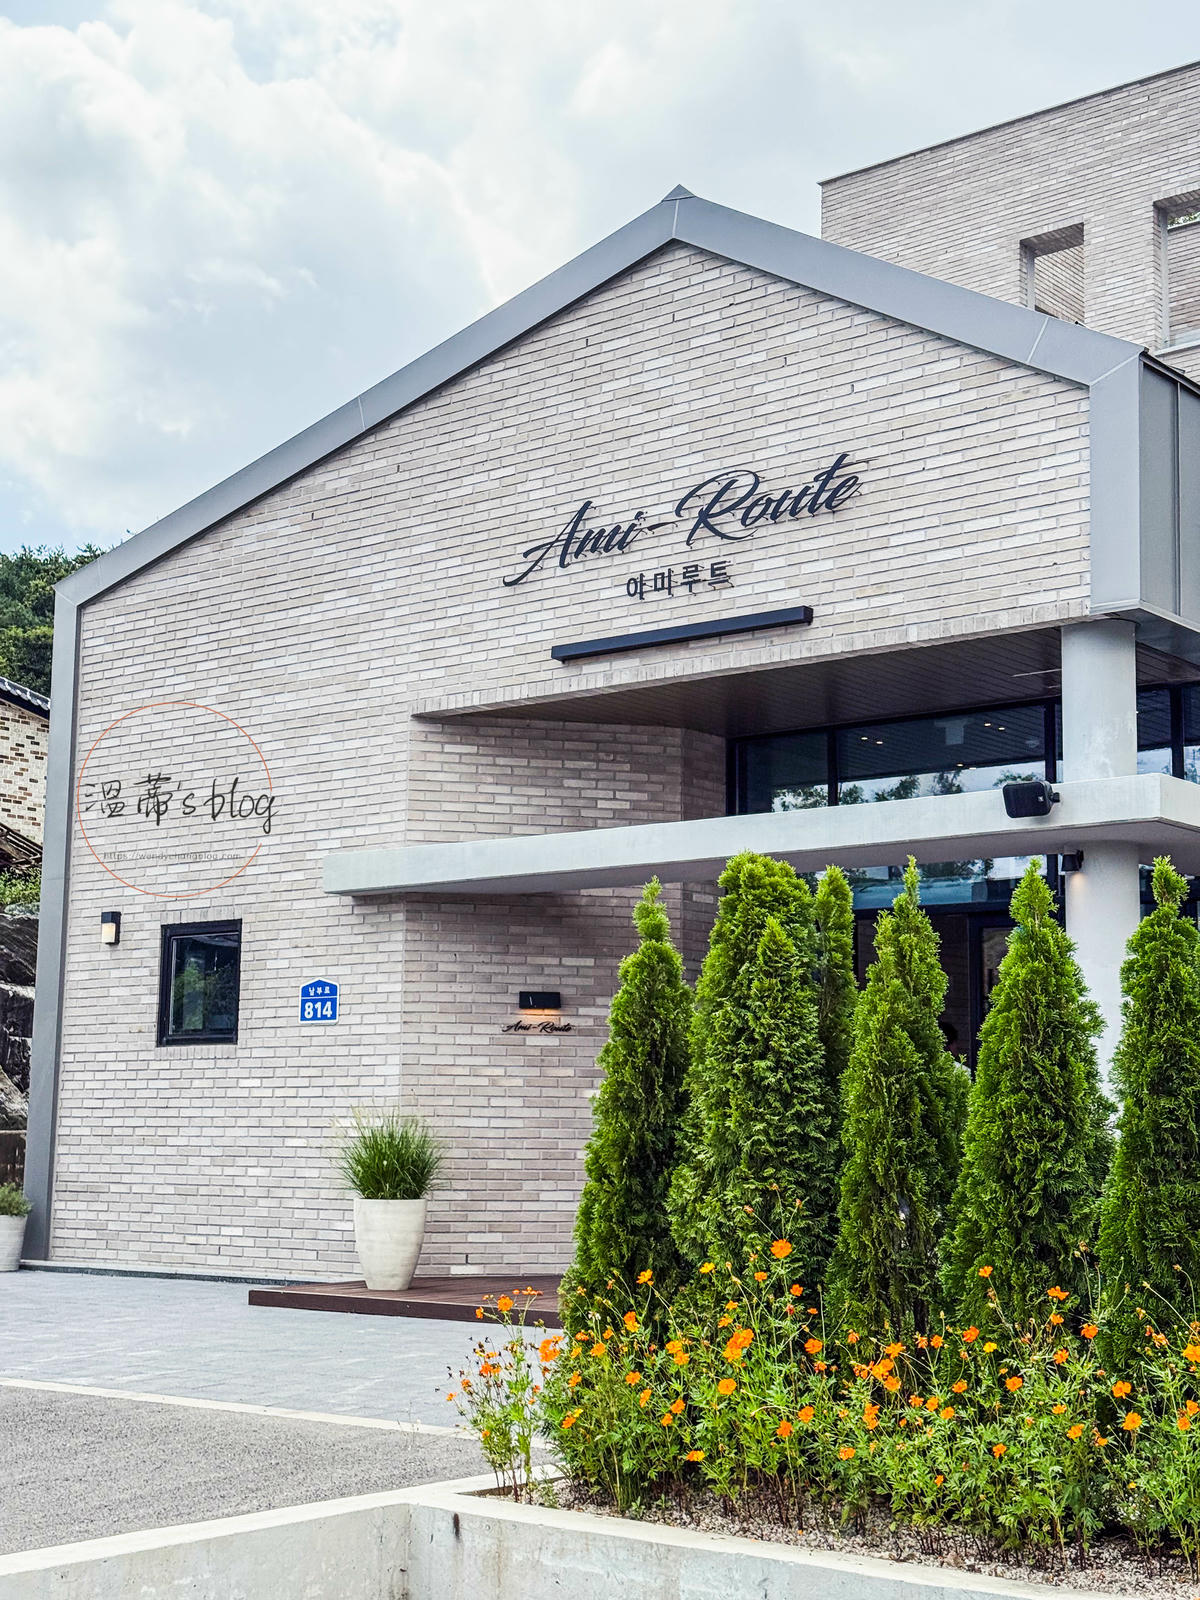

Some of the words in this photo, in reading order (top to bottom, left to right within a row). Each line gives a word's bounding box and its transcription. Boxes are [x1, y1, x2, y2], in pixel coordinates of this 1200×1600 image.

[503, 454, 870, 586] Ami-Route
[626, 560, 730, 600] 아미루트
[304, 1001, 333, 1019] 814
[502, 1020, 575, 1033] Ami-Route
